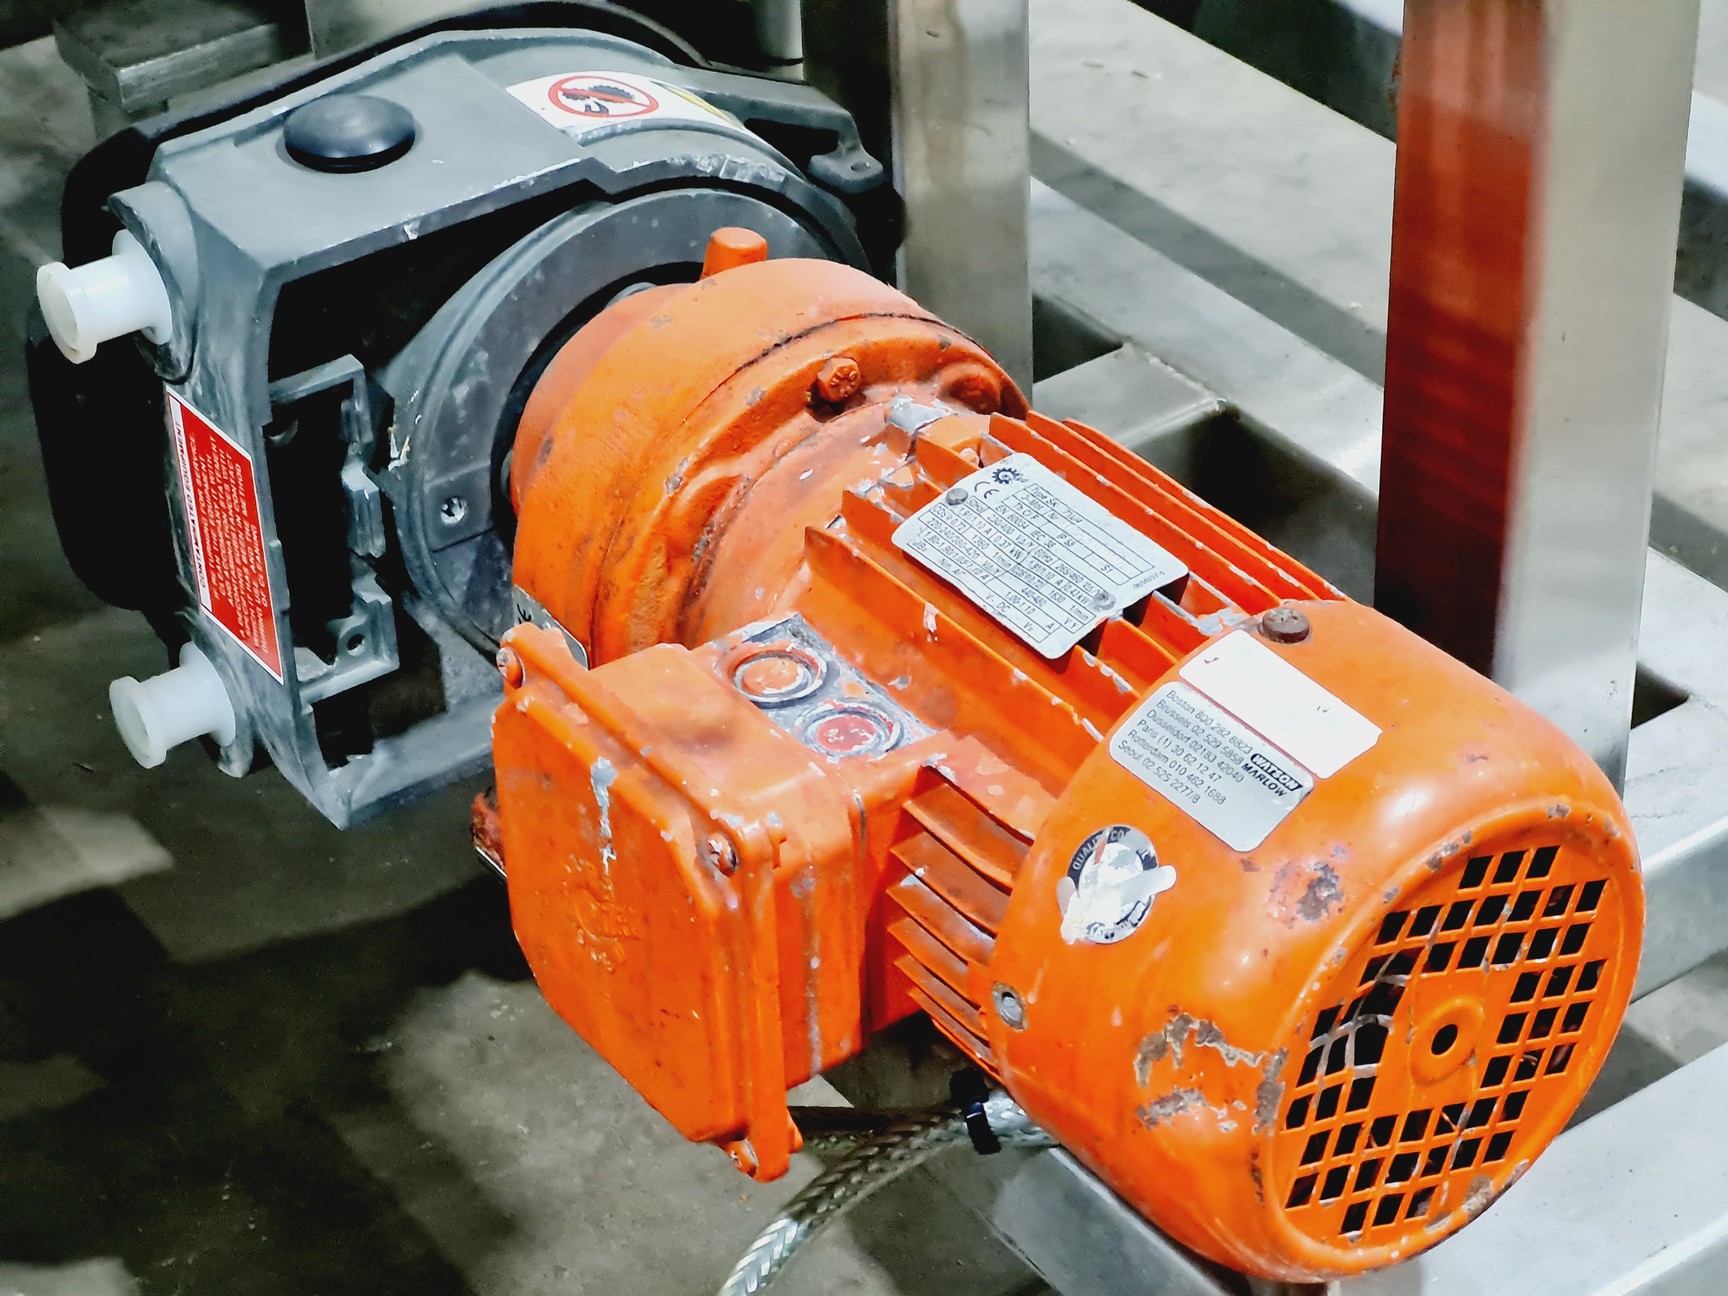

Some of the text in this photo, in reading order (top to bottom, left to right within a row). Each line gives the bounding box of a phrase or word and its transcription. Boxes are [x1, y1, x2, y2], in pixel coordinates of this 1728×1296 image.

[189, 434, 202, 487] SERVICE
[205, 453, 215, 485] WITH
[210, 435, 226, 509] STATEMENT
[226, 452, 239, 512] CONTACT
[175, 421, 205, 588] CONTAMINATED EQUIPMENT
[197, 487, 206, 514] FOR
[234, 462, 247, 517] METHOD
[199, 455, 226, 597] CLEAN THE EQUIPMENT
[213, 501, 230, 579] ACCOMPANY
[219, 448, 251, 638] SPECIFYING SUBSTANCES WITH
[237, 529, 247, 564] BEEN
[243, 519, 251, 543] THE
[992, 535, 1023, 559] 0.37 kW
[994, 504, 1008, 515] EN
[1029, 529, 1046, 541] IEC
[201, 515, 217, 586] RETURNING
[221, 510, 243, 626] DECONTAMINATION
[247, 545, 256, 573] AND
[250, 523, 268, 608] OF CLEANING
[1099, 564, 1114, 574] S1
[225, 579, 234, 607] AND
[243, 565, 251, 592] HAS
[249, 607, 260, 648] WHICH
[256, 606, 268, 654] DURING
[995, 601, 1011, 612] DC
[1155, 699, 1244, 765] Brussels 02 529 5858
[1165, 689, 1253, 755] Boston 800 282 8823
[1117, 739, 1201, 804] Seoul 02 525 2277/8
[1126, 729, 1226, 805] Rotterdam 010 462 1688
[1136, 718, 1222, 783] Paris (1) 30 62 12 47
[1188, 740, 1218, 763] 02183
[1215, 760, 1245, 783] 42040
[1250, 754, 1299, 790] WATSON
[1240, 762, 1287, 797] MARLOW
